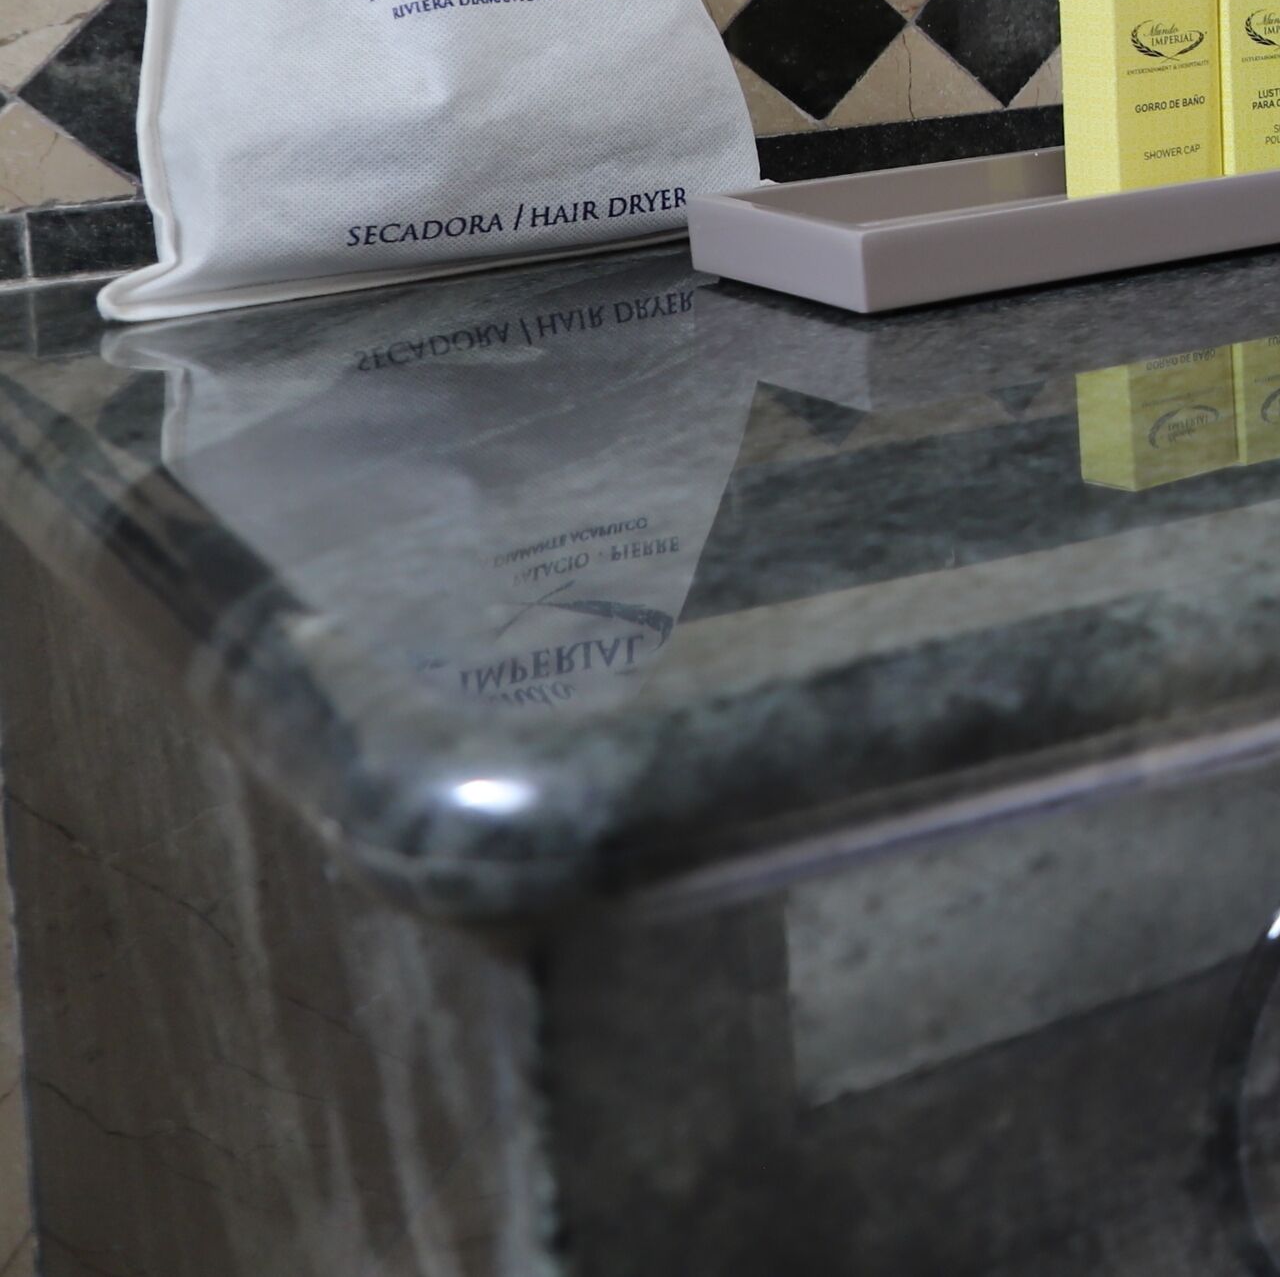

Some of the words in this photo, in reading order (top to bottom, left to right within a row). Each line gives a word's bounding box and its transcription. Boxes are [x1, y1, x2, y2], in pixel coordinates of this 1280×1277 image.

[1152, 33, 1194, 47] IMPERIAL
[1135, 100, 1167, 113] GORRO
[1169, 99, 1180, 109] DE
[1182, 93, 1206, 107] BAÑO
[1252, 100, 1275, 110] PARA
[1144, 146, 1183, 161] SHOWER
[1184, 143, 1200, 155] CAP
[347, 213, 503, 247] SECADORA
[530, 200, 599, 227] HAIR
[607, 187, 687, 218] DRYER
